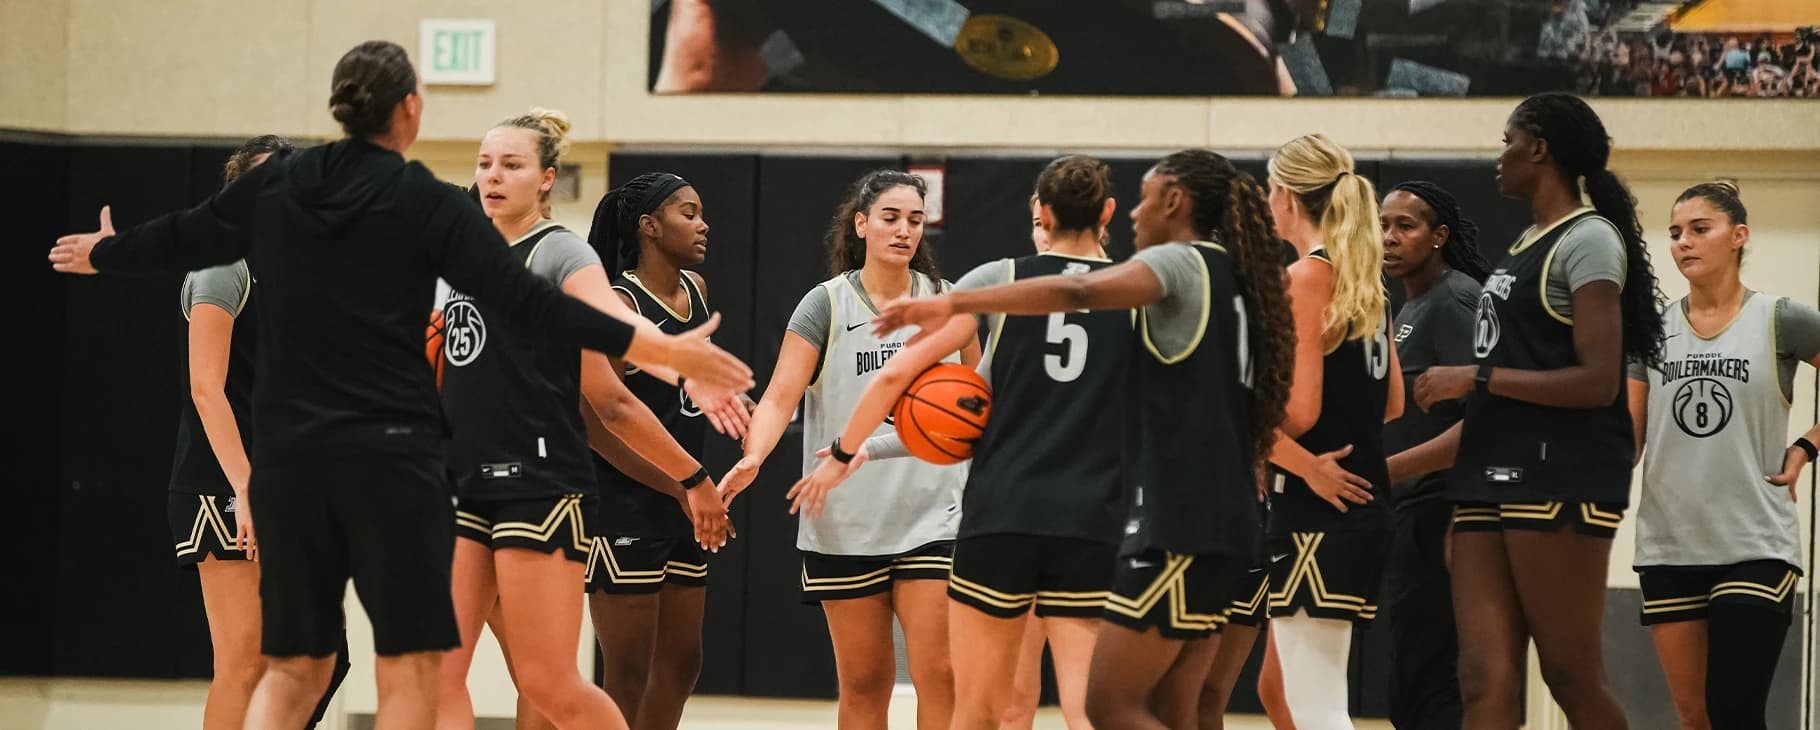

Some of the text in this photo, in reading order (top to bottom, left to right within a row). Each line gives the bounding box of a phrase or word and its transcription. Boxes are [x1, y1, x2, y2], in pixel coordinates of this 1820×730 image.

[433, 30, 484, 72] EXIT
[452, 327, 471, 356] 25
[1044, 308, 1090, 382] 5
[1662, 359, 1749, 386] BOILERMAKERS
[1696, 402, 1708, 428] 8
